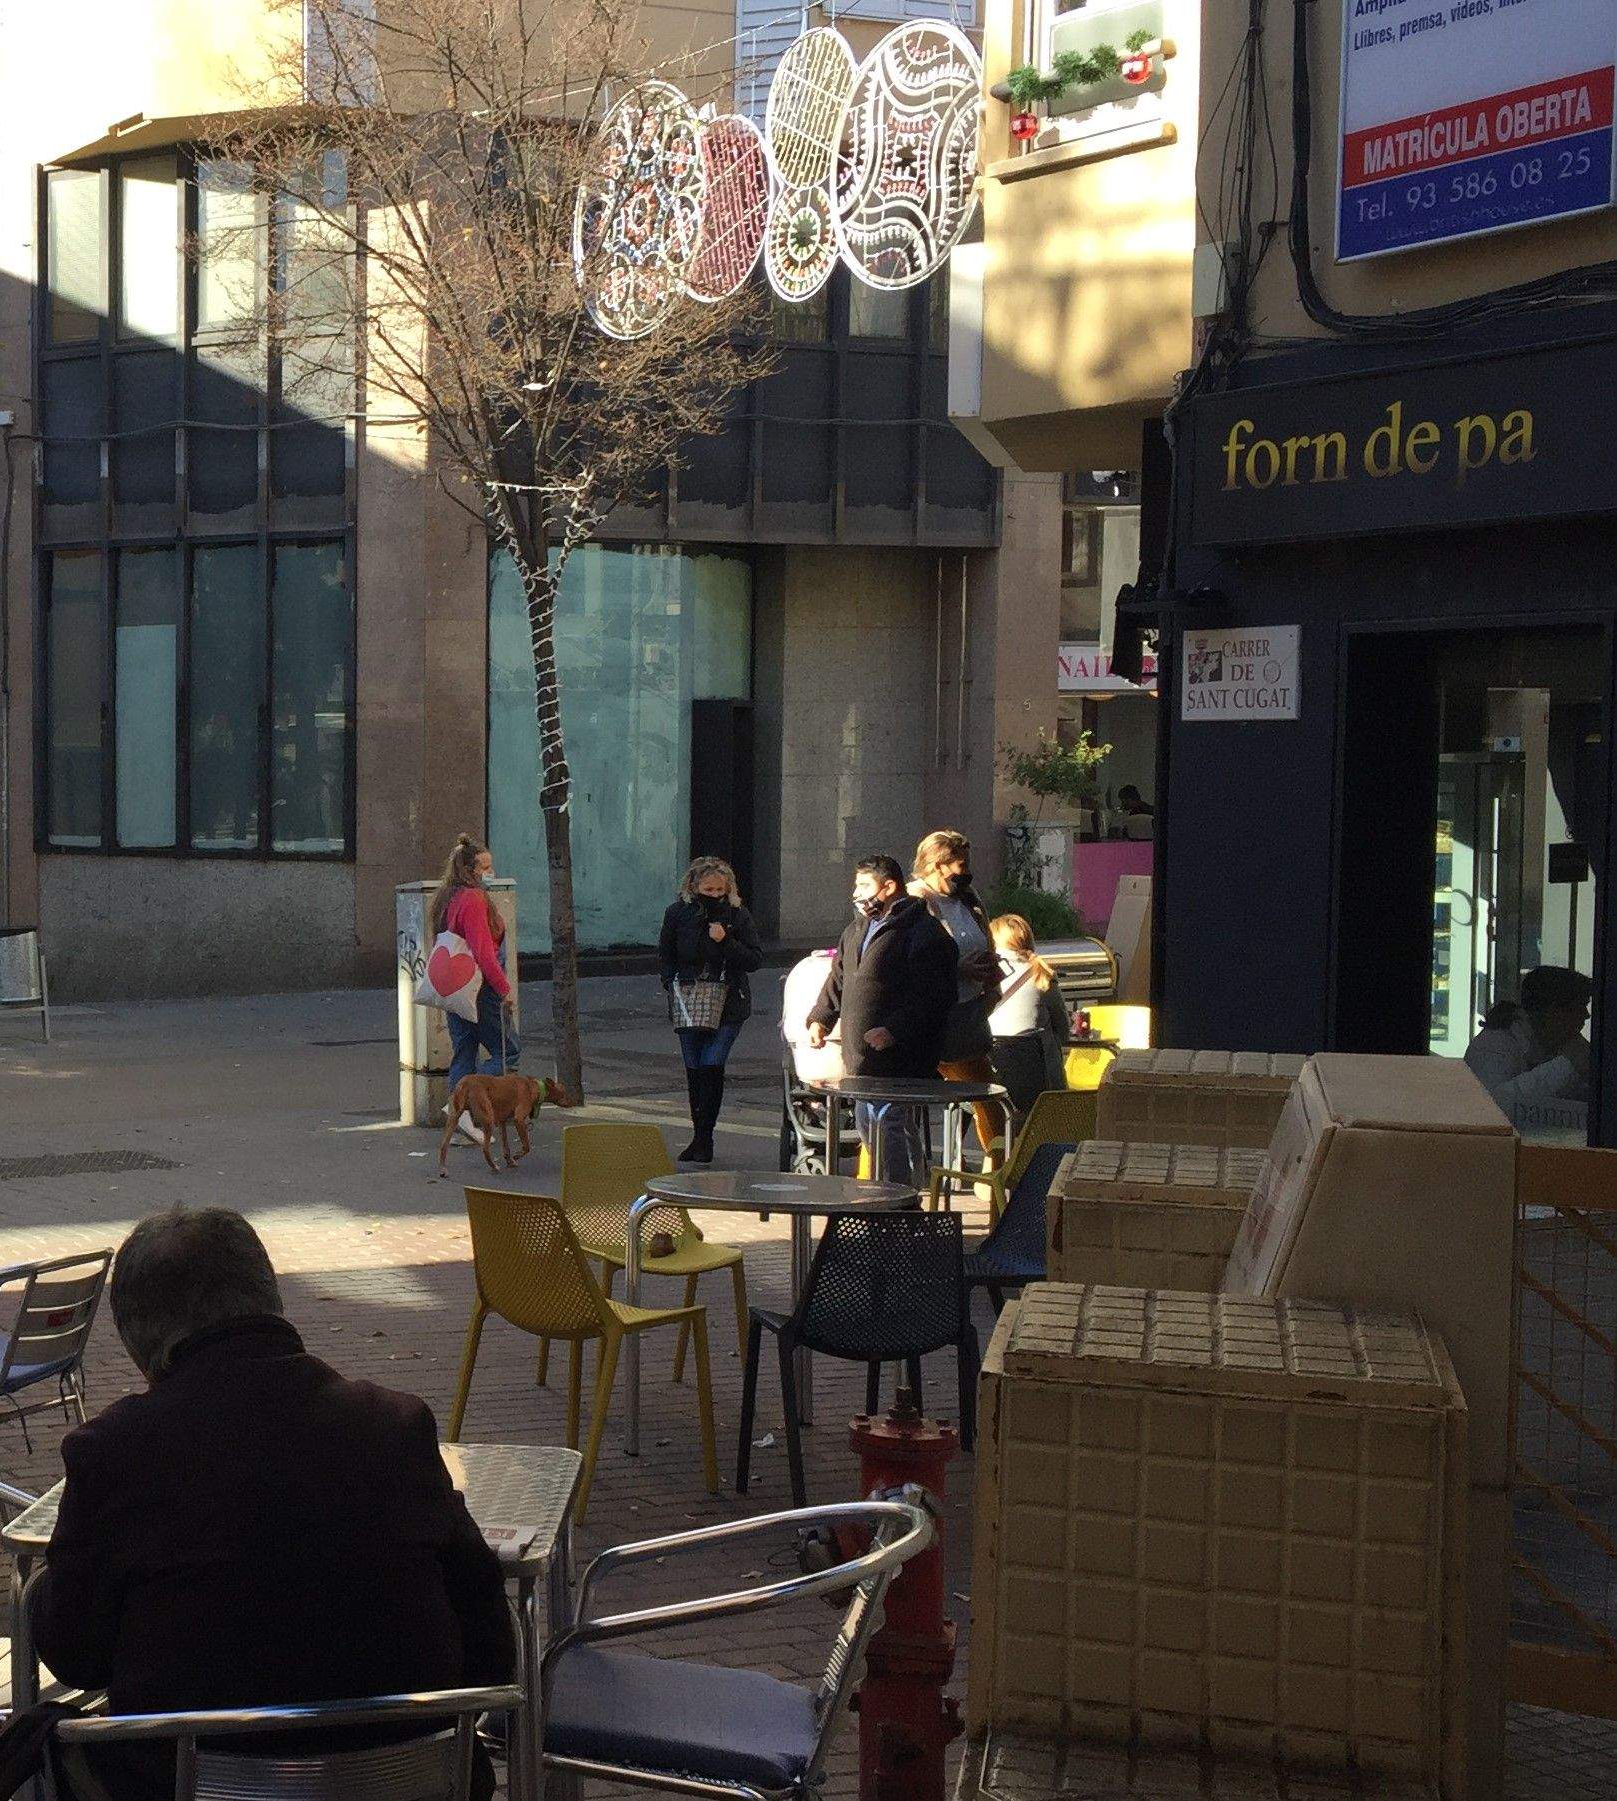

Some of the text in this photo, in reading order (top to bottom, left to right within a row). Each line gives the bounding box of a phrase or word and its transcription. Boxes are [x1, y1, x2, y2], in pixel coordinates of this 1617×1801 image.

[1354, 26, 1395, 50] Llibres,
[1400, 11, 1447, 42] premsa,
[1363, 86, 1593, 176] MATRÍCULA OBERTA
[1357, 191, 1394, 223] Tel.
[1406, 182, 1437, 212] 93
[1450, 170, 1498, 204] 586
[1510, 158, 1543, 189] 08
[1556, 147, 1591, 180] 25
[1220, 400, 1537, 492] forn de pa
[1222, 639, 1271, 659] CARRER
[1230, 663, 1256, 682] DE
[1187, 687, 1291, 710] SANT CUGAT
